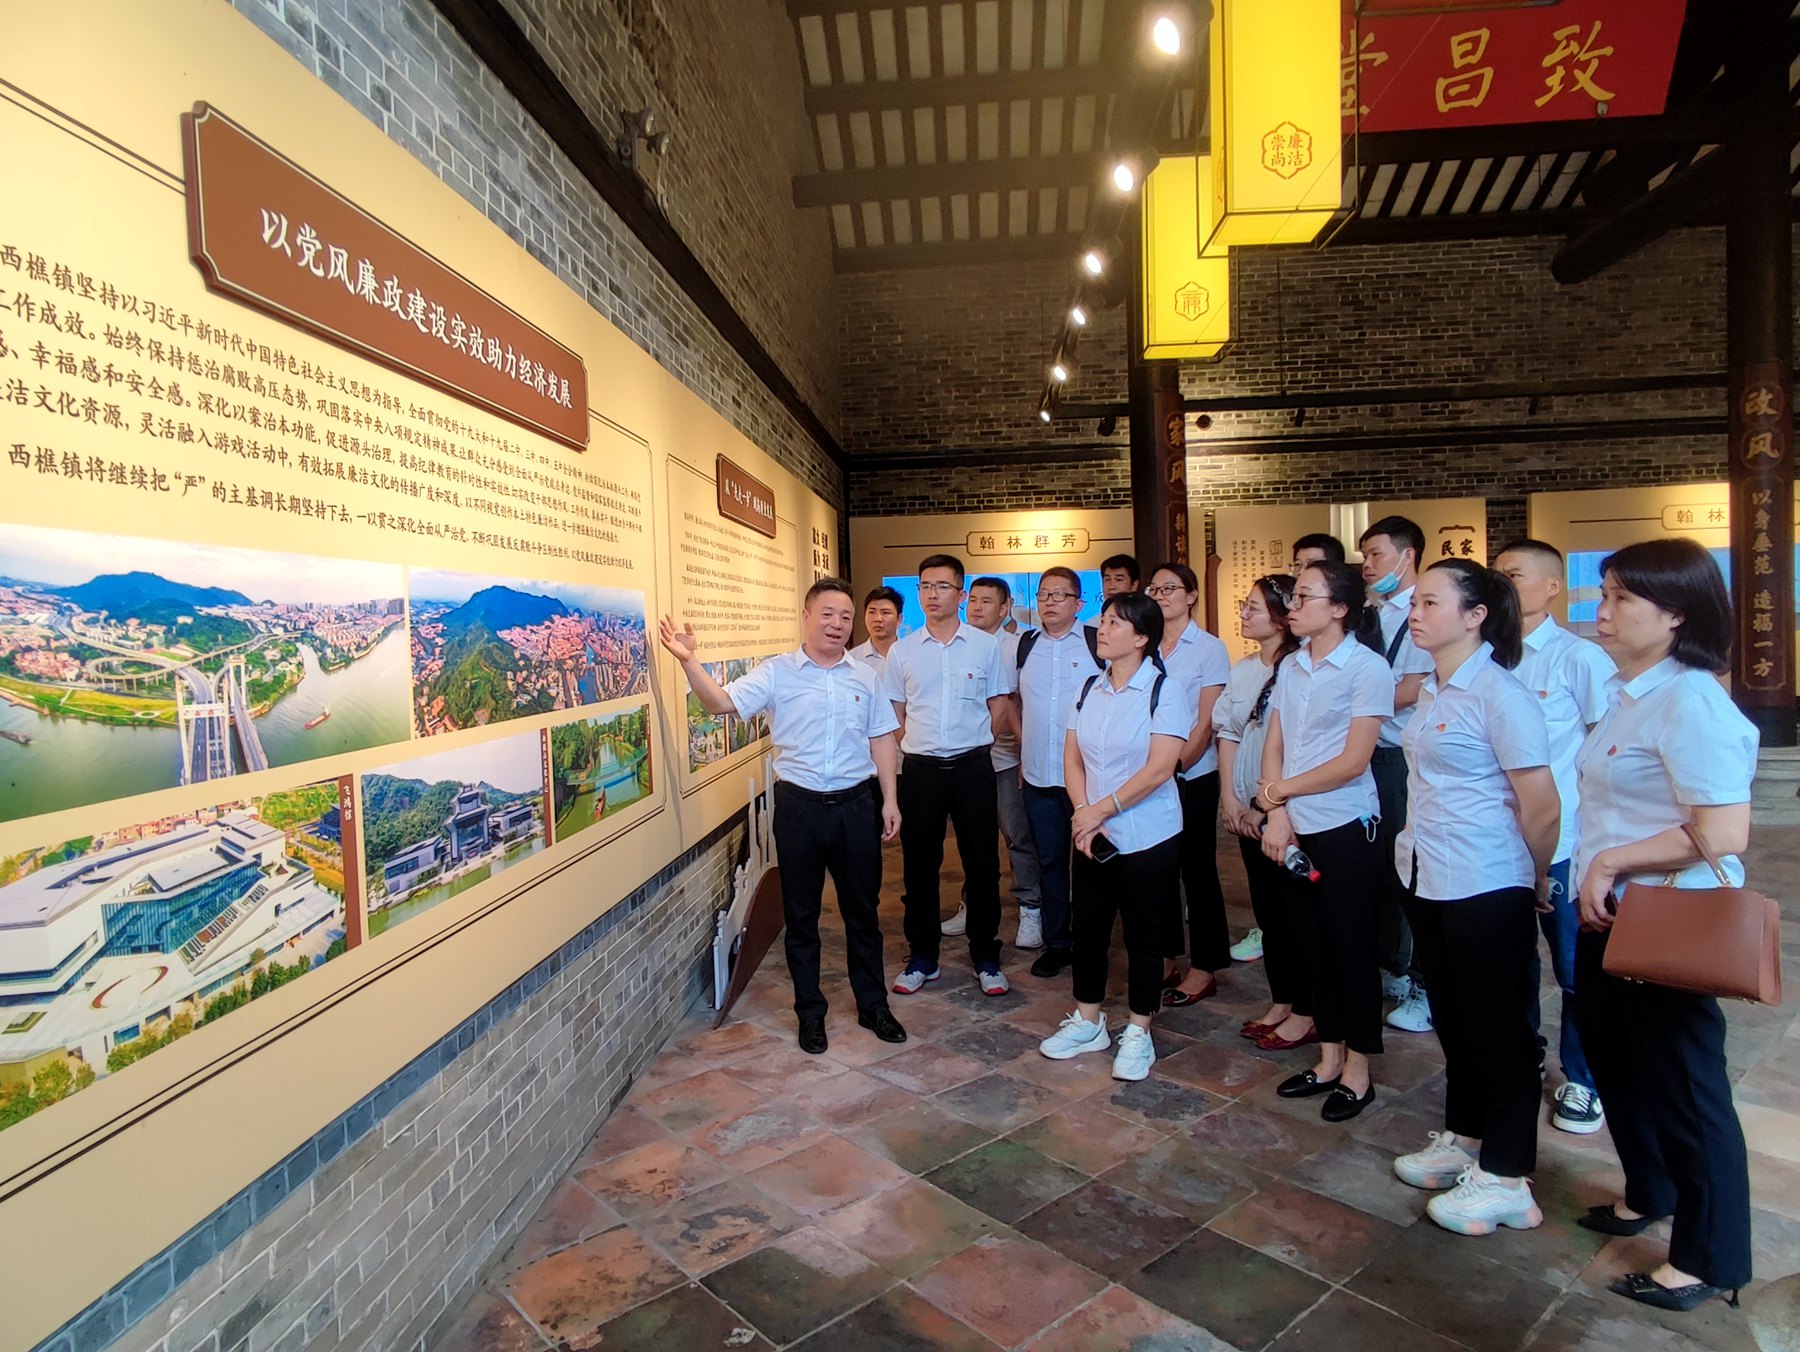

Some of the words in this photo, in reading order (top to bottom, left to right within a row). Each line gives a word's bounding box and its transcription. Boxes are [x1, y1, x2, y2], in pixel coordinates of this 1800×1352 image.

[260, 207, 573, 409] 以党风廉政建设实效助力经济发展
[979, 533, 1077, 550] 翰林群芳
